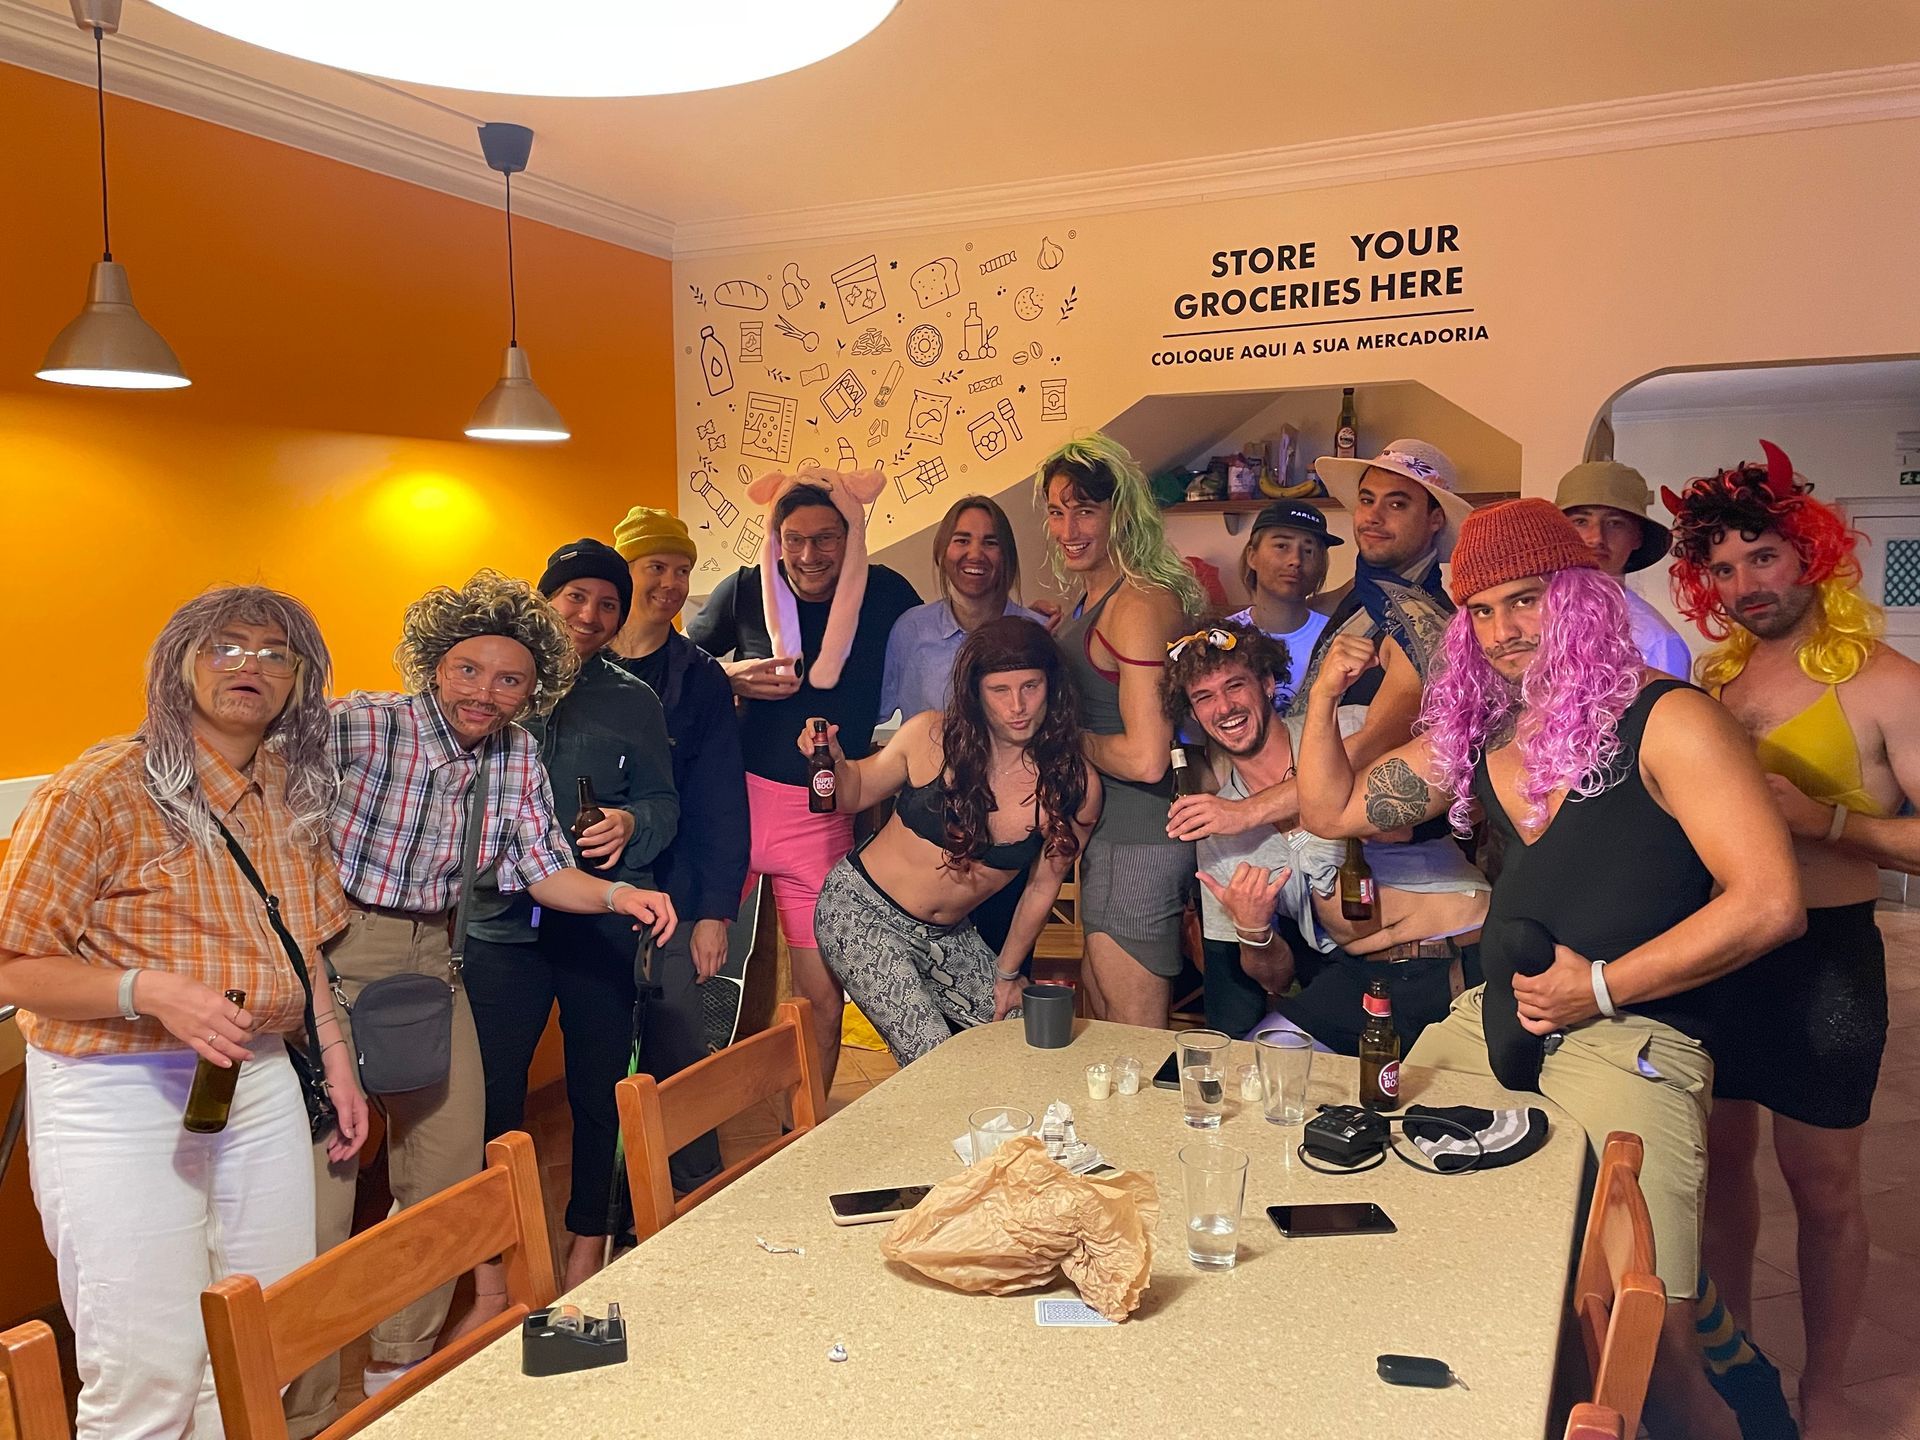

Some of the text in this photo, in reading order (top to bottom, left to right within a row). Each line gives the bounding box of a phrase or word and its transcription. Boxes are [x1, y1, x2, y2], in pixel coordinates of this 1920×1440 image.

[1211, 224, 1460, 278] STORE YOUR
[1174, 266, 1463, 320] GROCERIES HERE
[1151, 325, 1490, 367] COLOQUE AQUI A SUA MERCADORIA
